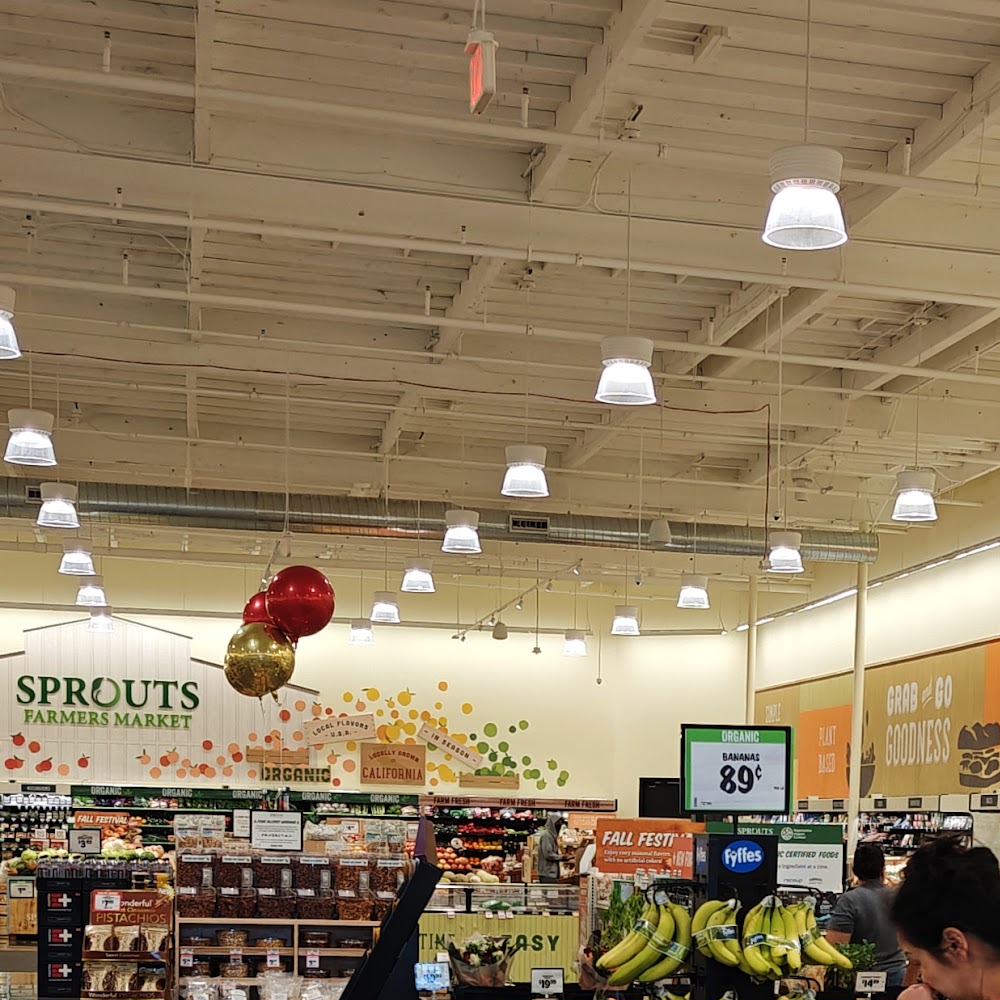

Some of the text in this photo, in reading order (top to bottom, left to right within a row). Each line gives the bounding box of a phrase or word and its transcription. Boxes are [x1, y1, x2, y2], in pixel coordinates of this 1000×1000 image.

[16, 675, 200, 710] SPROUTS
[886, 674, 953, 717] GRAB GO
[24, 709, 192, 729] FARMERS MARKET
[311, 719, 370, 736] LOCAL FLAVORS
[721, 730, 760, 743] ORGANIC
[818, 726, 837, 747] PLANT
[885, 717, 951, 768] GOODNESS
[430, 732, 470, 760] IN SEASON
[368, 749, 420, 763] LOCALLY GROWN
[722, 752, 760, 762] BANANAS
[818, 752, 836, 774] BASED
[261, 767, 331, 783] ORGANIC
[362, 766, 423, 781] CALIFORNIA
[91, 787, 122, 796] ORGANIC
[162, 788, 193, 798] ORGANIC
[232, 790, 263, 799] ORGANIC
[302, 792, 332, 801] ORGANIC
[370, 794, 400, 804] ORGANIC
[433, 796, 470, 805] FARM FRESH
[499, 798, 535, 807] FARM FRESH
[564, 800, 580, 808] FARM
[78, 815, 128, 824] FALL FESTIVAL
[737, 827, 774, 835] SPROUTS
[602, 831, 634, 846] FALL
[785, 851, 817, 859] CERTIFIED
[818, 851, 839, 859] FOODS
[96, 912, 166, 923] PISTACHIOS
